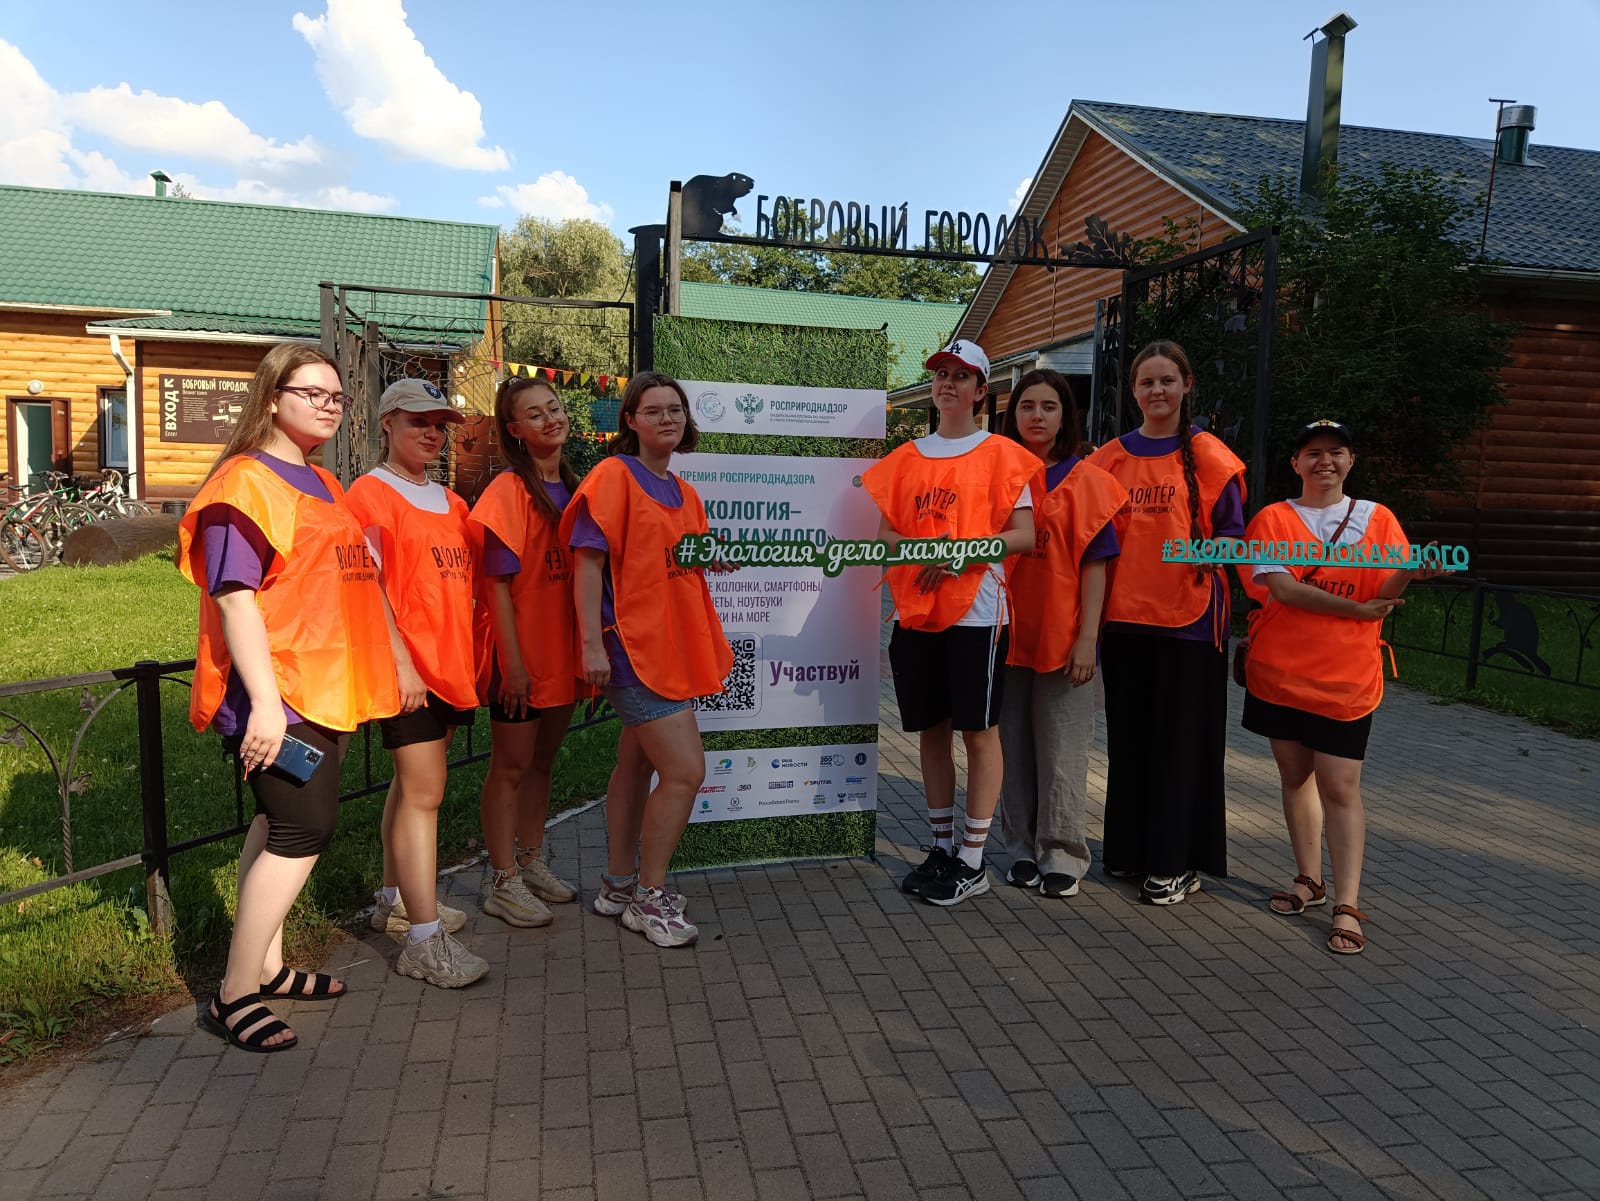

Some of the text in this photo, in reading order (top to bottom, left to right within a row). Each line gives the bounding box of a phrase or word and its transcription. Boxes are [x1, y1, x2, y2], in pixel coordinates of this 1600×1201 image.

[757, 194, 1054, 273] БОБРОВЫЙ ГОРОДОК
[182, 379, 216, 390] БОБРОВЫЙ
[219, 381, 250, 393] ГОРОДОК
[164, 390, 180, 430] ВХОД
[770, 400, 848, 415] РОСПРИРОДНАДЗОР
[680, 470, 815, 485] ПРЕМИЯ РОСПРИРОДНАДЗОРА
[1128, 483, 1176, 504] ЛОНТЁР
[704, 499, 802, 521] КОЛОГИЯ–
[678, 536, 816, 563] #Экология
[1161, 538, 1470, 569] #ЭКОЛОГИЯДЕЛОКАЖДОГО
[715, 580, 762, 593] КОЛОНКИ,
[764, 580, 823, 594] СМАРТФОНЫ,
[737, 596, 783, 608] НОУТБУКИ
[731, 611, 744, 622] НА
[746, 611, 770, 622] МОРЕ
[769, 659, 860, 687] Участвуй
